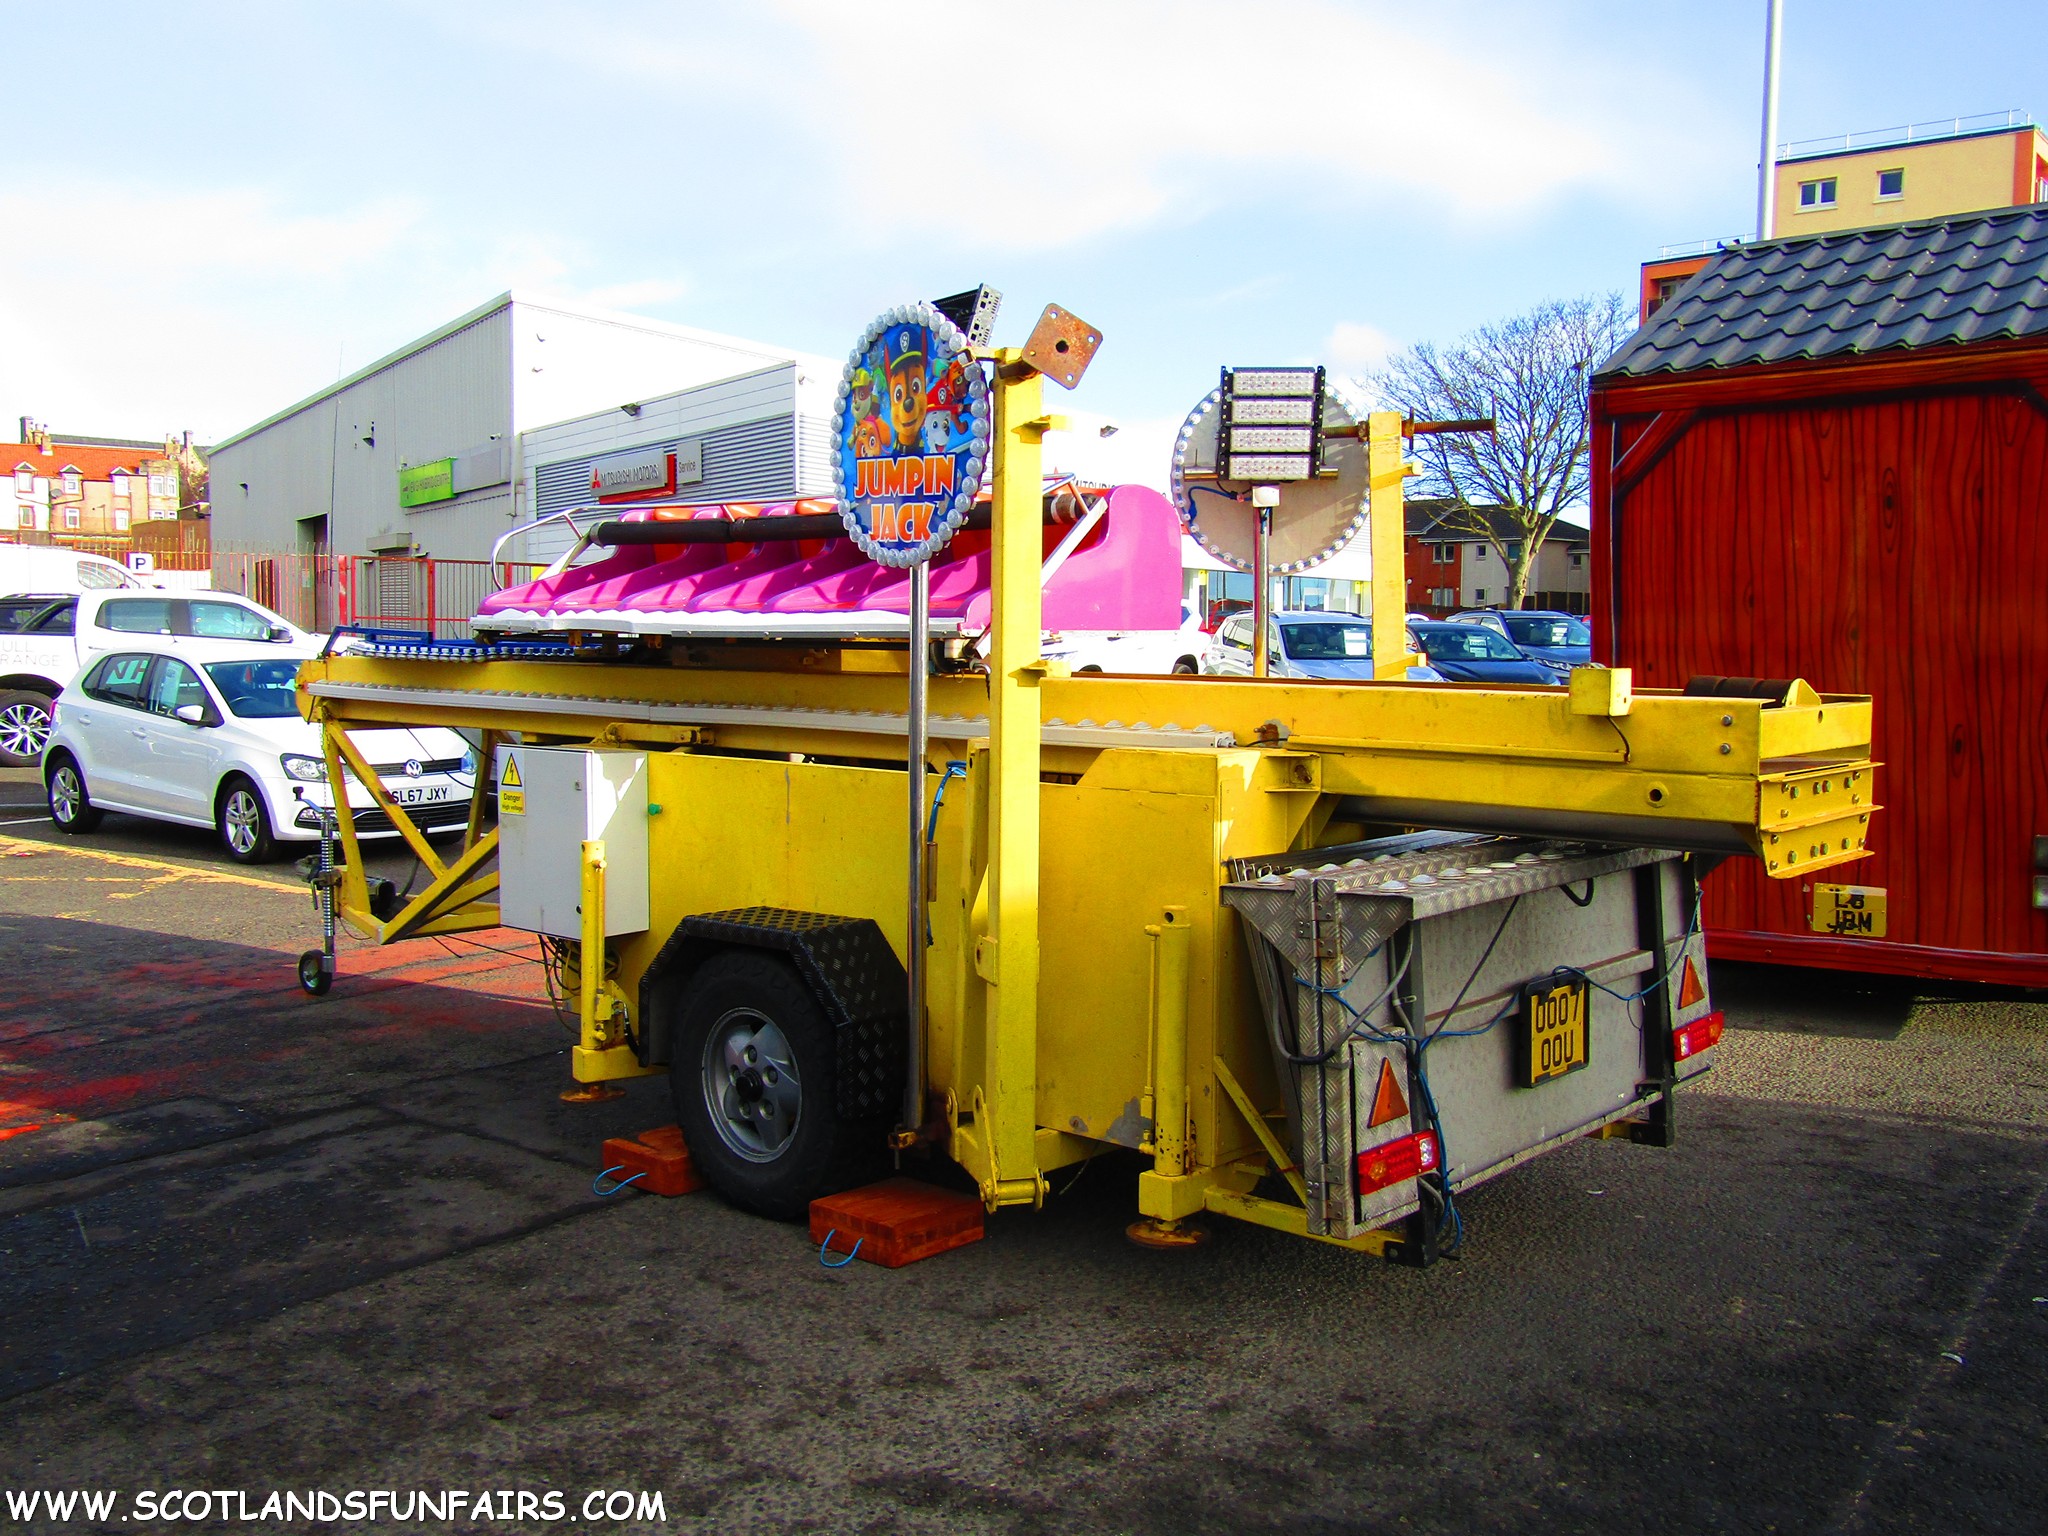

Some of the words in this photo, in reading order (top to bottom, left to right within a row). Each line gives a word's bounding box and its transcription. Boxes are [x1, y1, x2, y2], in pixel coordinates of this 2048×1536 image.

[601, 467, 633, 487] MITSUBISHI
[633, 464, 659, 482] MOTORS
[679, 461, 696, 473] Service
[854, 454, 956, 498] JUMPIN
[869, 501, 936, 543] JACK
[135, 557, 146, 570] P
[391, 788, 423, 804] SL67
[426, 787, 448, 801] JXY
[503, 792, 521, 803] Danger
